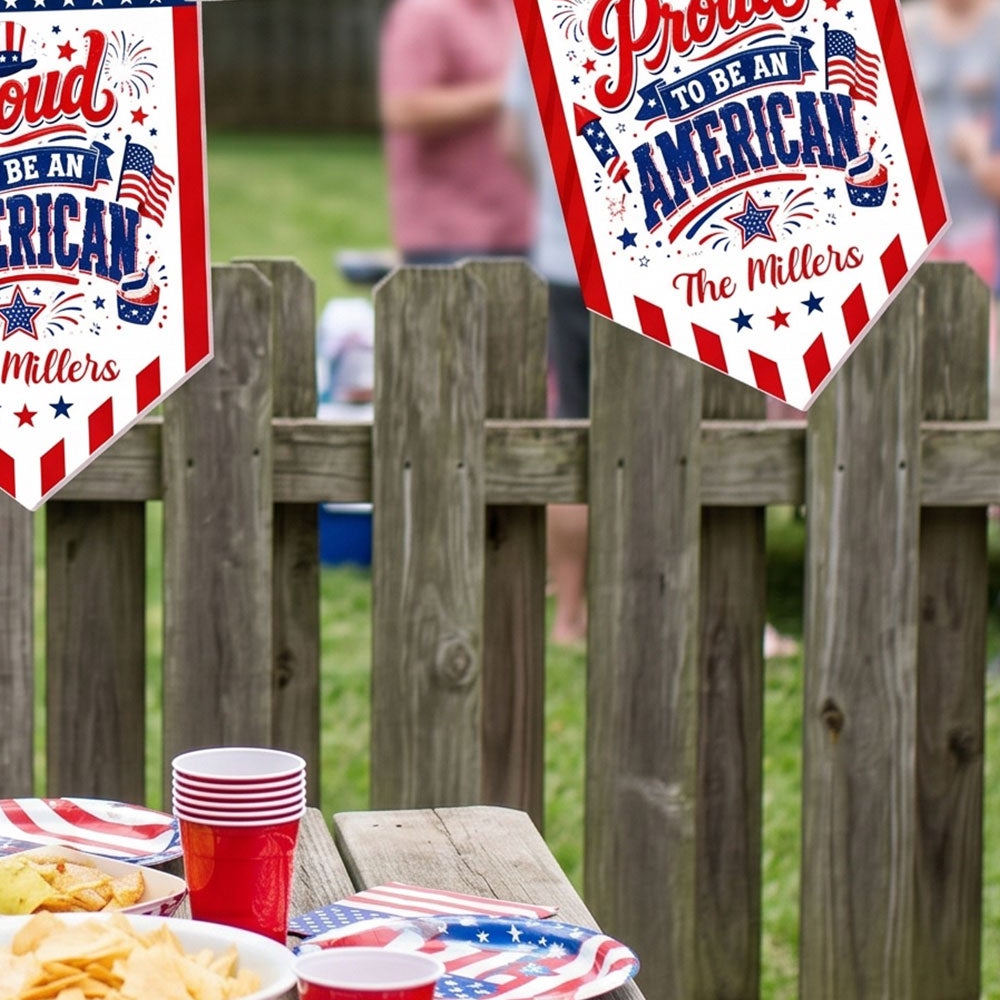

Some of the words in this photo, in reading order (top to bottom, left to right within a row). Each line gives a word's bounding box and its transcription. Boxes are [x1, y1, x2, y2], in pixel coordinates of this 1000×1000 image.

[670, 82, 703, 111] TO
[713, 65, 747, 94] BE
[754, 51, 788, 80] AN
[6, 157, 41, 182] BE
[48, 154, 84, 179] AN
[631, 90, 862, 233] AMERICAN
[672, 269, 737, 307] The
[747, 244, 864, 290] Millers
[0, 349, 120, 387] Millers
